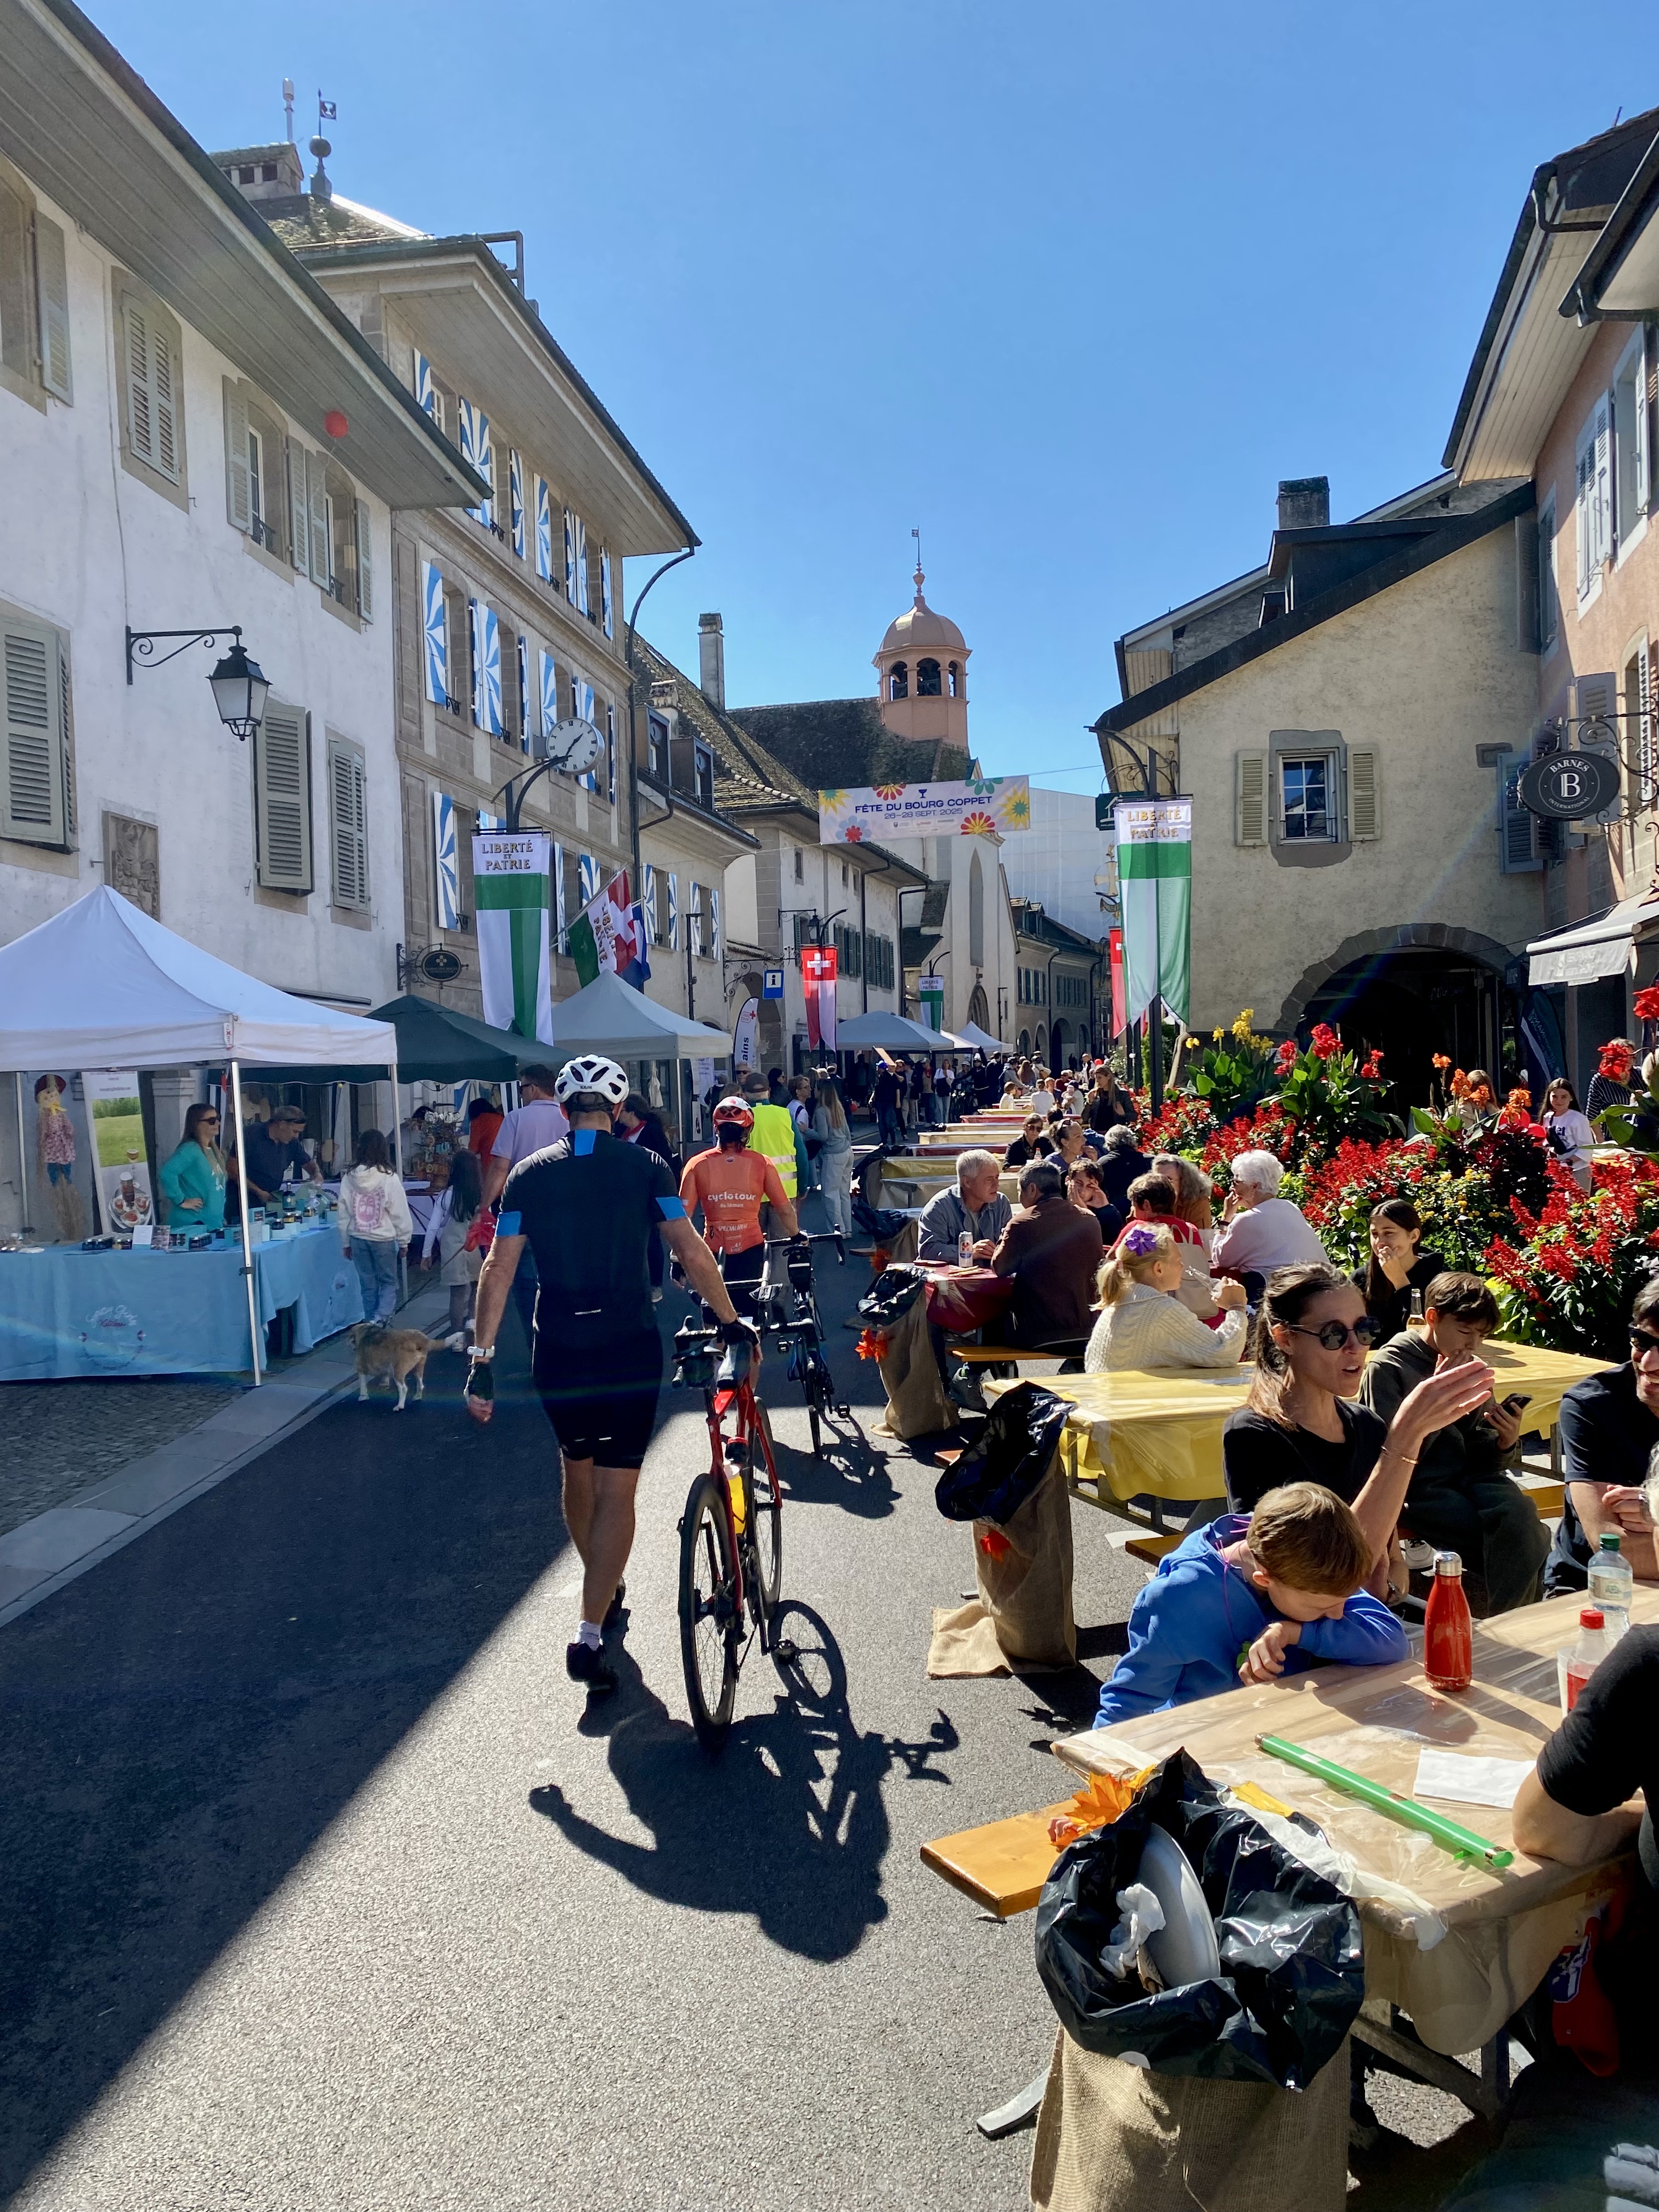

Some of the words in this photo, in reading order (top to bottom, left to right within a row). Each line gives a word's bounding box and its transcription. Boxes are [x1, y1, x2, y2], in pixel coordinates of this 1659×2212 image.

[1549, 759, 1590, 773] BARNES
[1560, 773, 1581, 798] B
[855, 803, 883, 814] FÊTE
[886, 802, 902, 811] DU
[905, 799, 944, 810] BOURG
[947, 796, 992, 807] COPPET
[1548, 796, 1590, 809] INTERNATIONAL
[940, 808, 963, 816] 2025
[1127, 807, 1182, 822] LIBERTÉ
[1131, 827, 1179, 839] PATRIE
[482, 839, 533, 854] LIBERTÉ
[486, 860, 531, 871] PATRIE
[741, 1037, 749, 1061] ains
[707, 1192, 756, 1201] cyclotour
